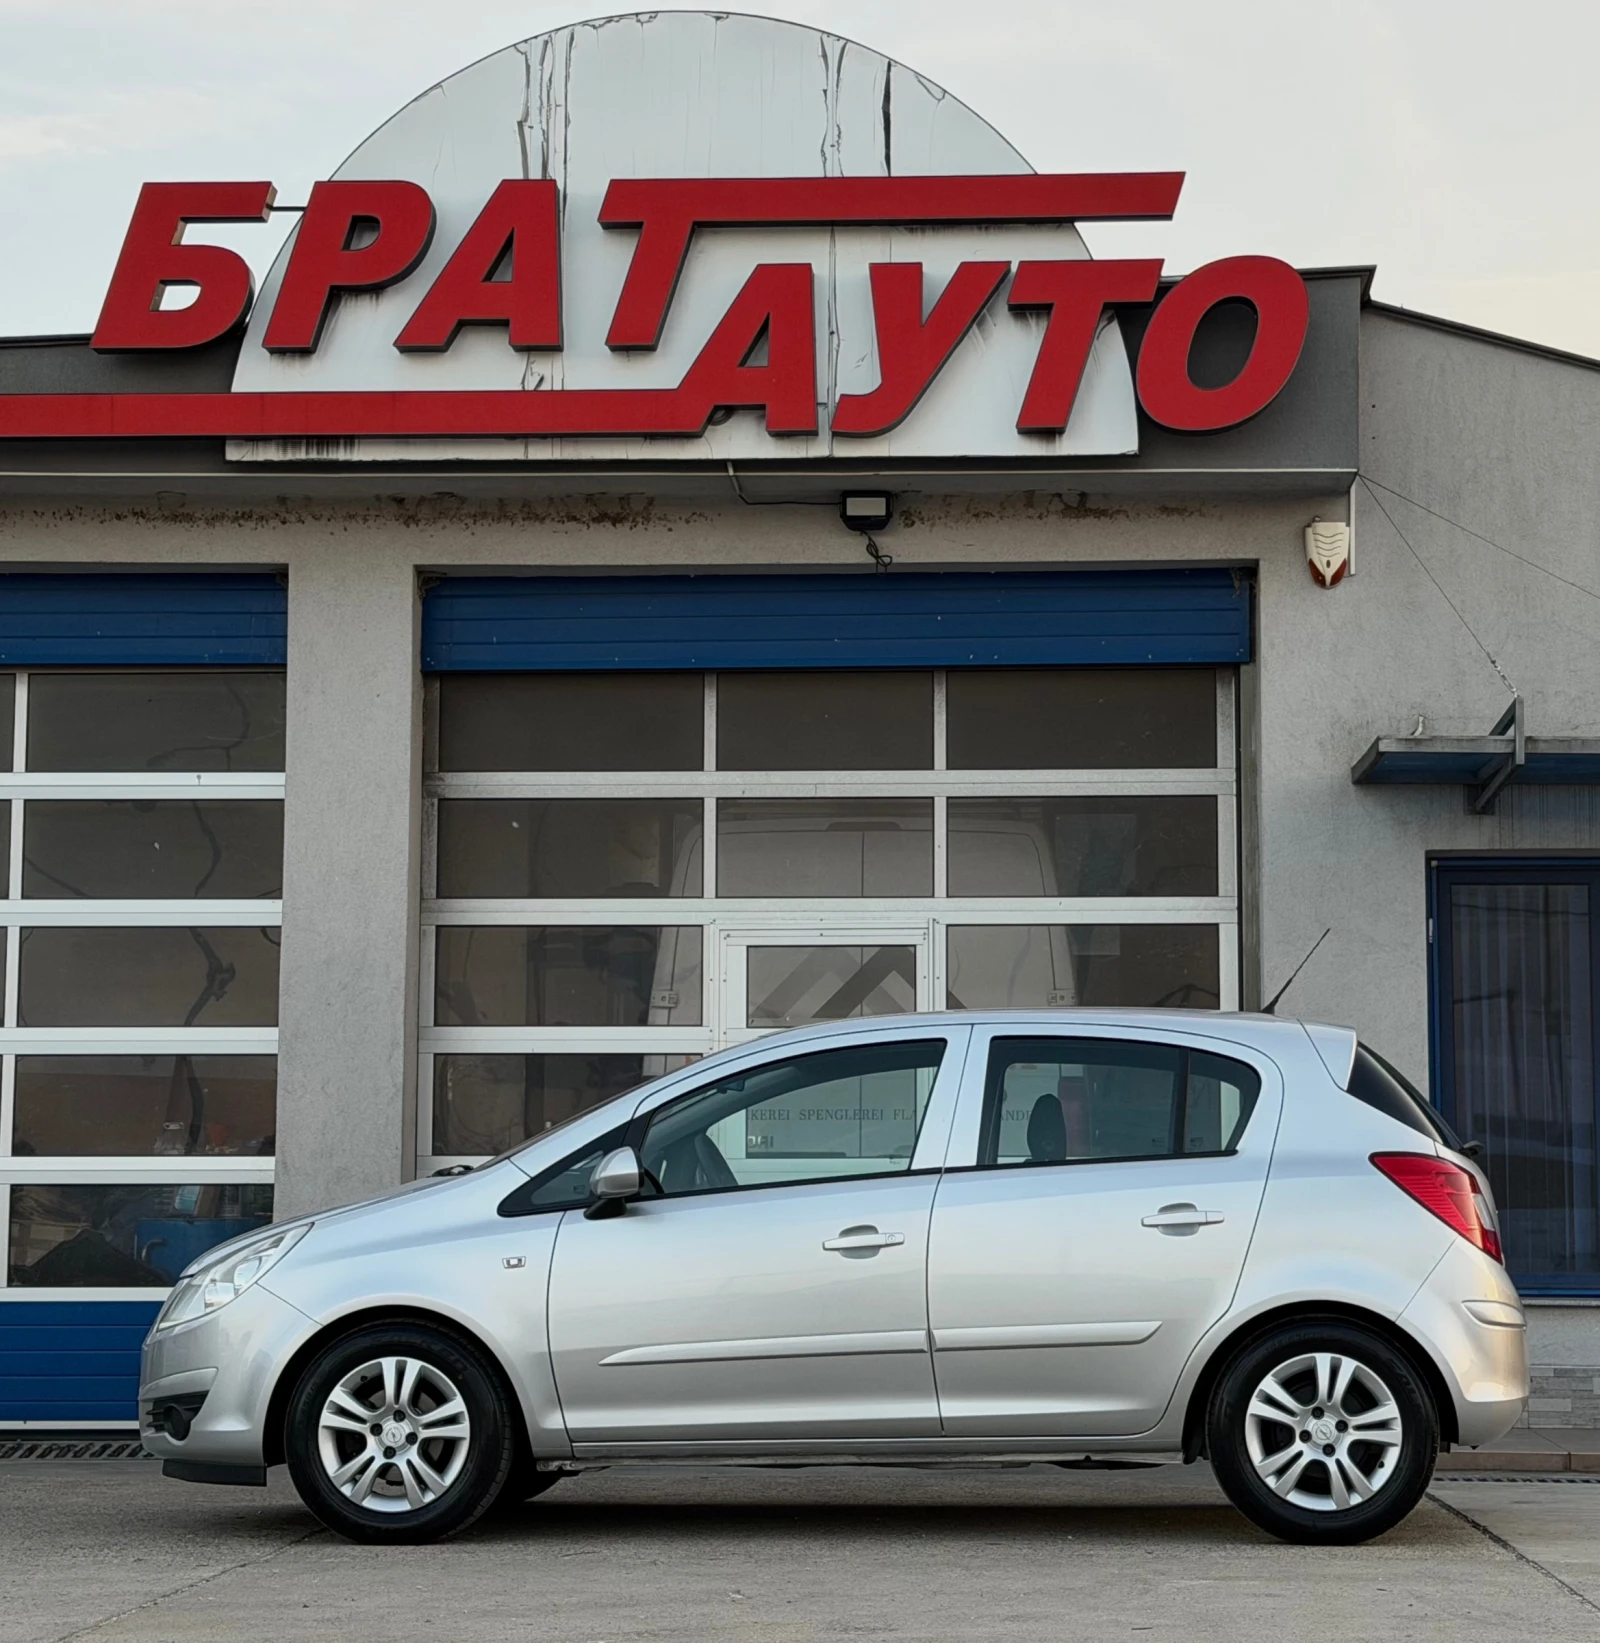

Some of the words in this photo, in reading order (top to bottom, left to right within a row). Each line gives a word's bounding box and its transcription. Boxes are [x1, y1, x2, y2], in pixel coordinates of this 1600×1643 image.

[90, 172, 1186, 353] БРАТ
[749, 1108, 791, 1121] KEREI
[798, 1108, 885, 1121] SPENGLEREI
